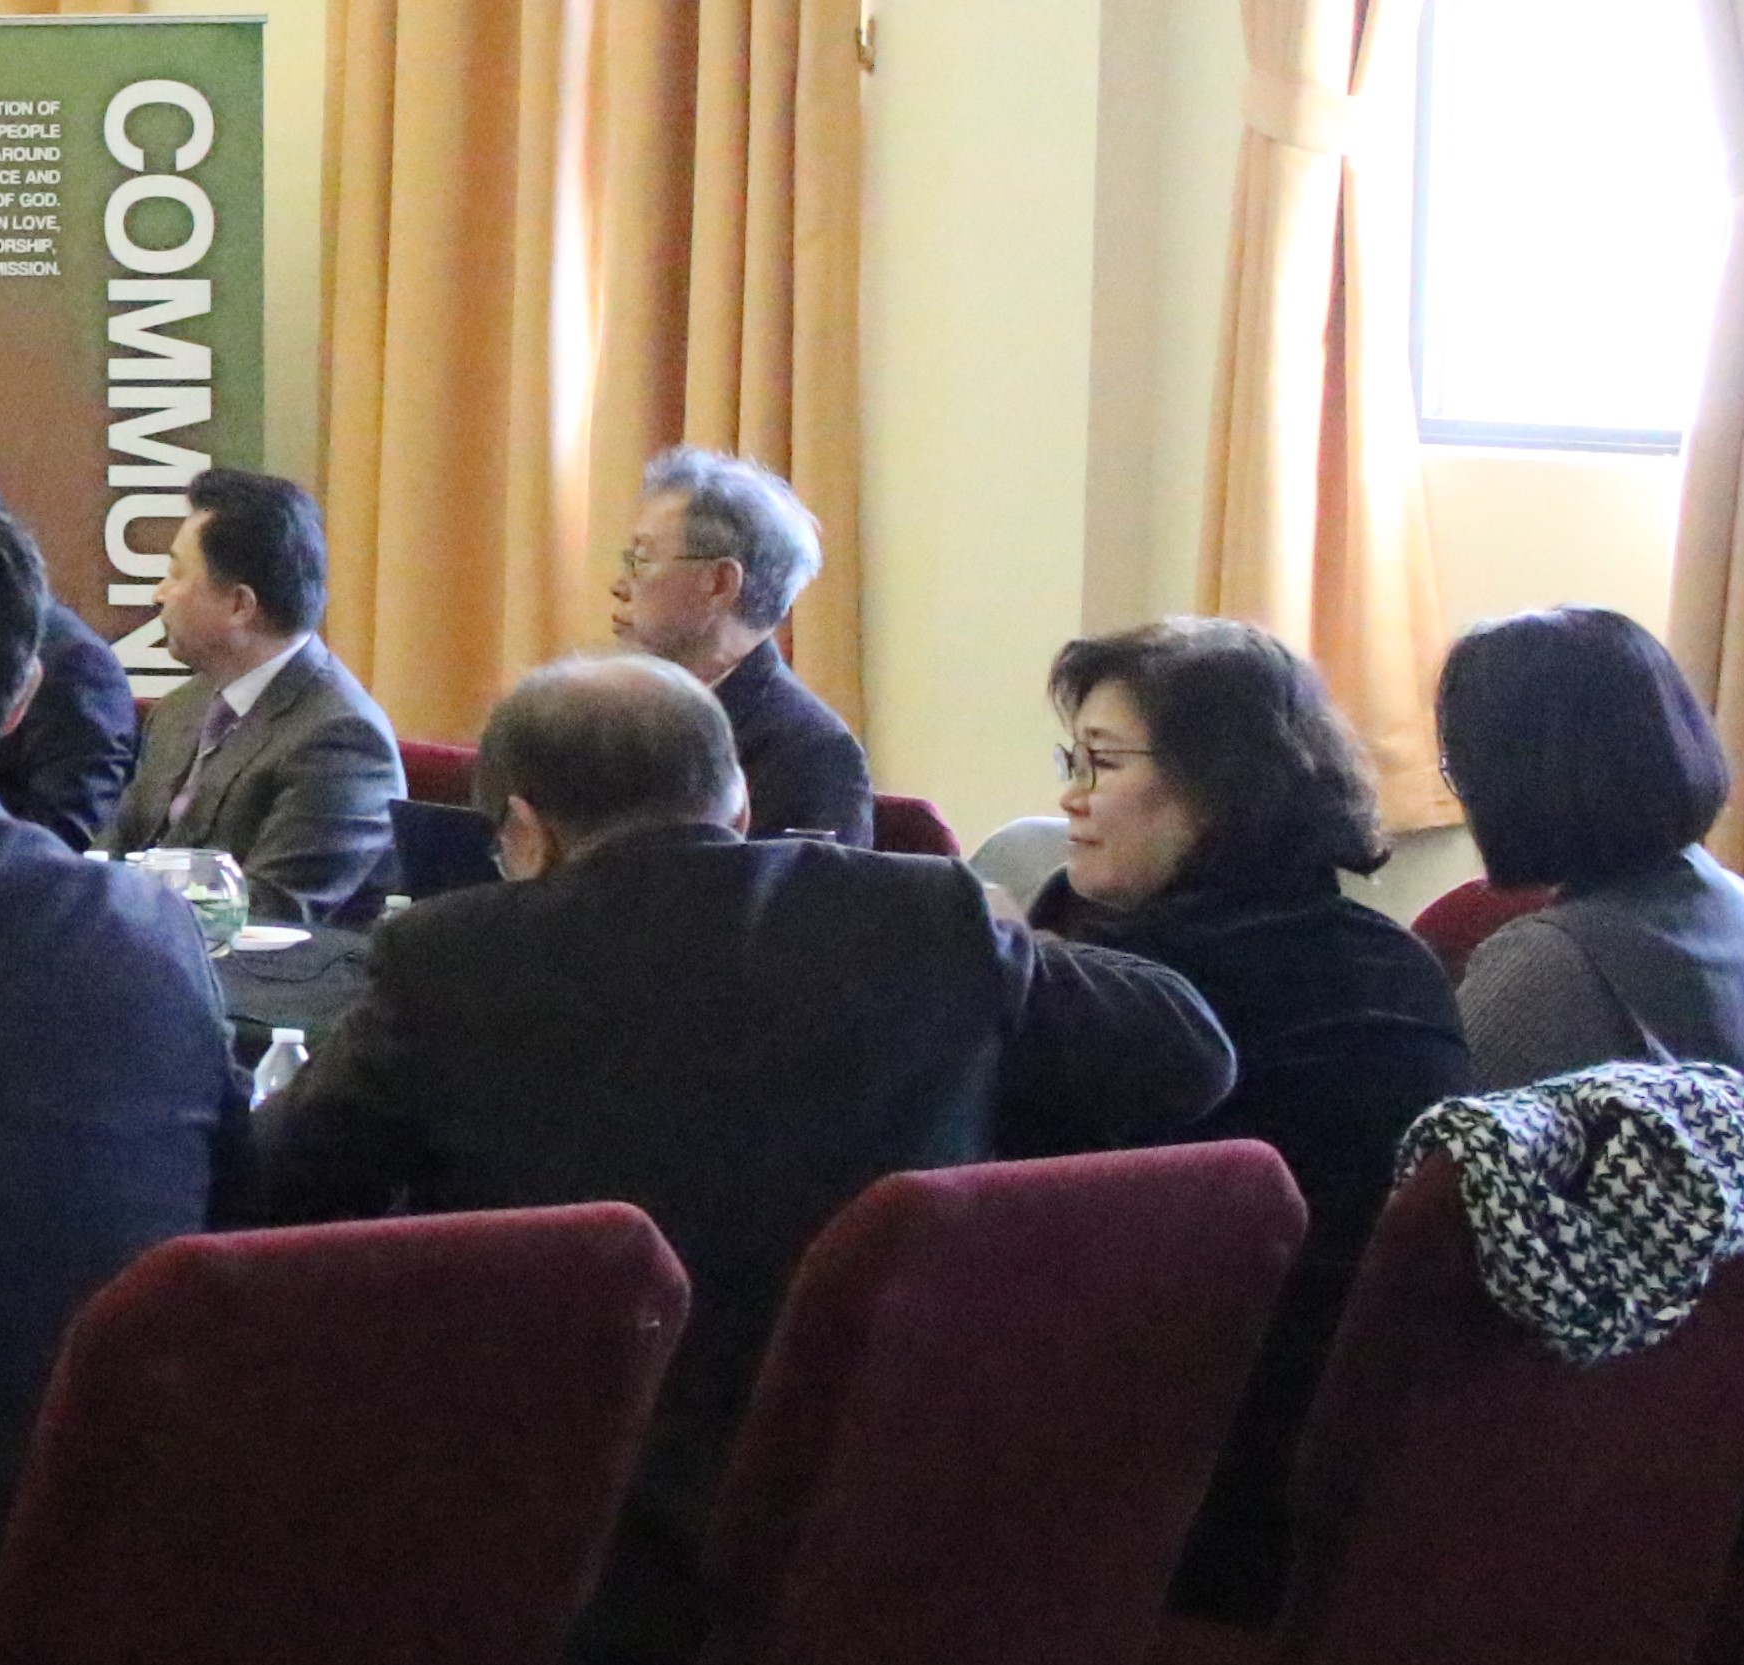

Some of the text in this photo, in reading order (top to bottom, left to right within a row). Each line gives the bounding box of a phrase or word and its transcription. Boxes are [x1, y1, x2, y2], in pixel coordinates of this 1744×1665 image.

[37, 101, 60, 115] OF
[26, 170, 60, 184] AND
[19, 193, 60, 207] GOD.
[12, 216, 60, 232] LOVE,
